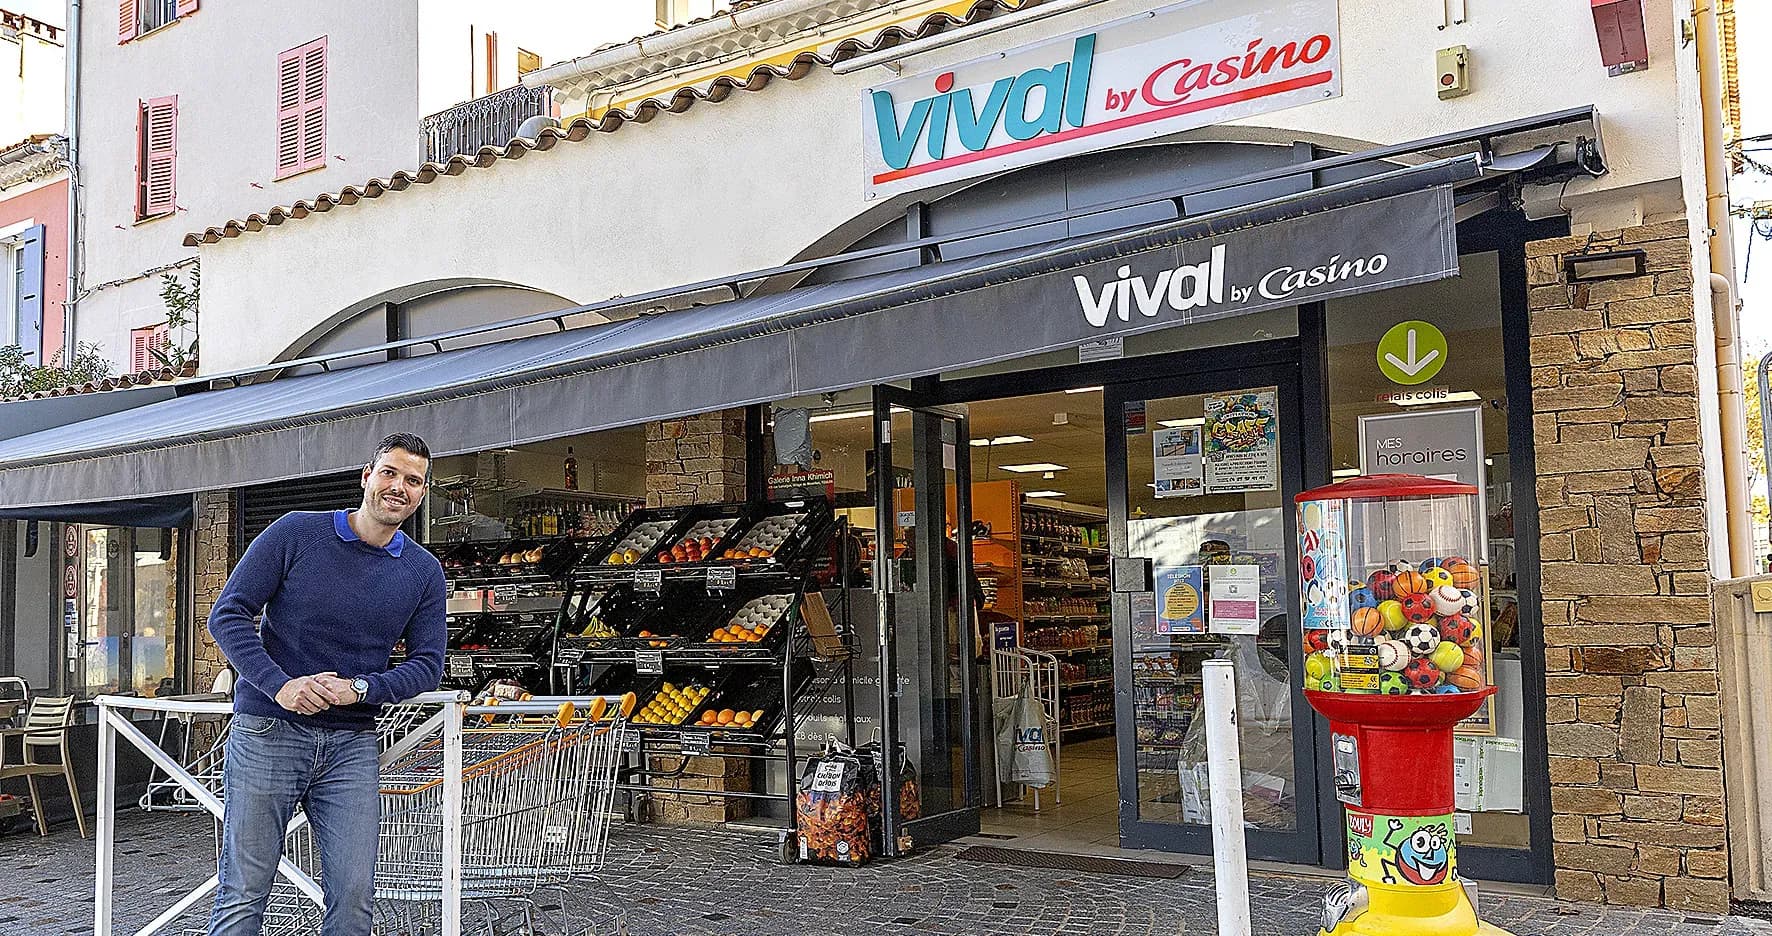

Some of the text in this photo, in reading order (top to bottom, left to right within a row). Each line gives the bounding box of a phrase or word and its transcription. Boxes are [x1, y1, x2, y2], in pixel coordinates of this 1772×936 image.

[872, 32, 1332, 171] vival by Casino
[1074, 244, 1388, 328] vival by Casino
[1376, 388, 1448, 402] relais colis
[1376, 438, 1402, 449] MES
[1376, 447, 1467, 466] horaires
[768, 476, 790, 485] Galerie
[822, 694, 842, 703] colis
